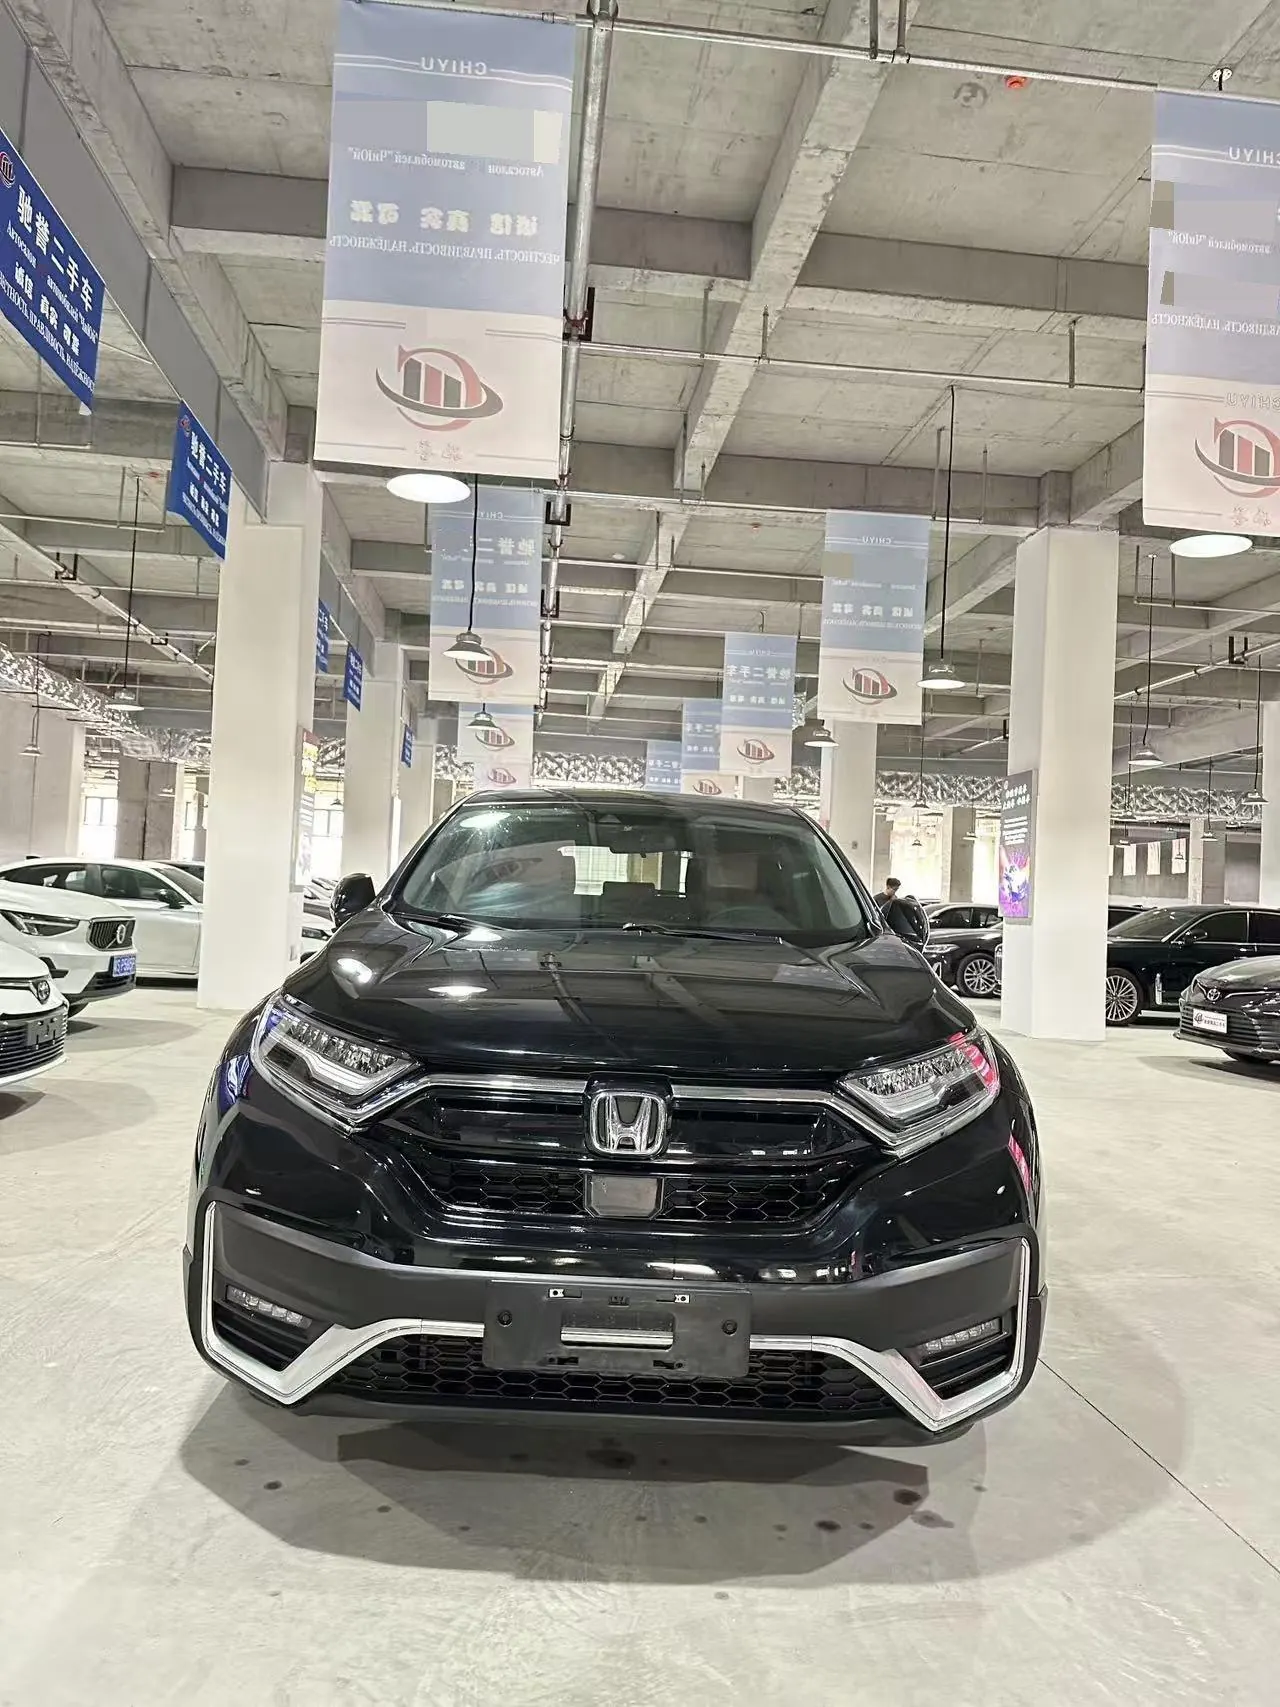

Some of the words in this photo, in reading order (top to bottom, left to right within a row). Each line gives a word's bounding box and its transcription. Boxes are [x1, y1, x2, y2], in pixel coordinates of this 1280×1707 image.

[6, 220, 38, 268] Автосалон
[17, 185, 94, 312] 驰誉二手车
[14, 262, 34, 300] 诚信
[40, 294, 58, 330] 真实
